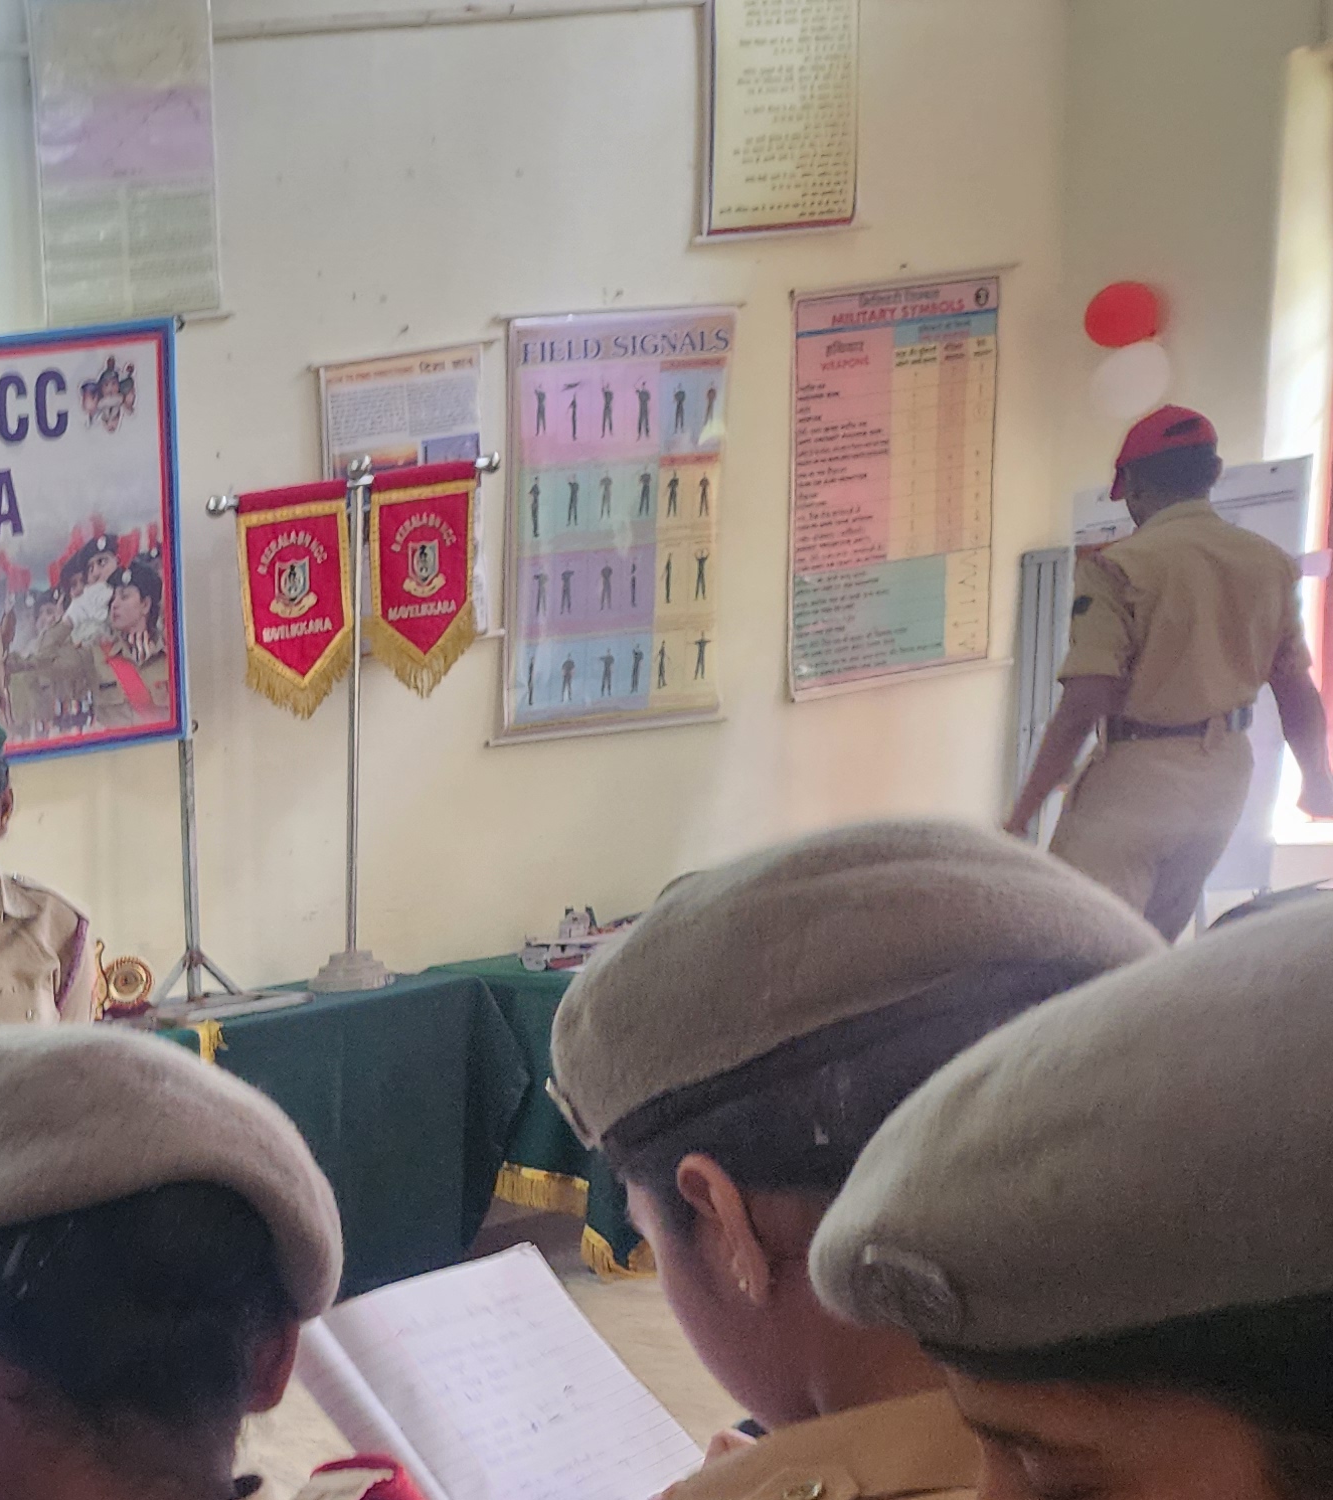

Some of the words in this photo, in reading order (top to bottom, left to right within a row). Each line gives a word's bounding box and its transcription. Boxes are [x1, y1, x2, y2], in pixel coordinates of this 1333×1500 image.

[832, 307, 897, 326] MILITARY
[900, 299, 966, 319] SYMBOLS
[520, 337, 601, 365] FIELD
[611, 328, 730, 358] SIGNALS
